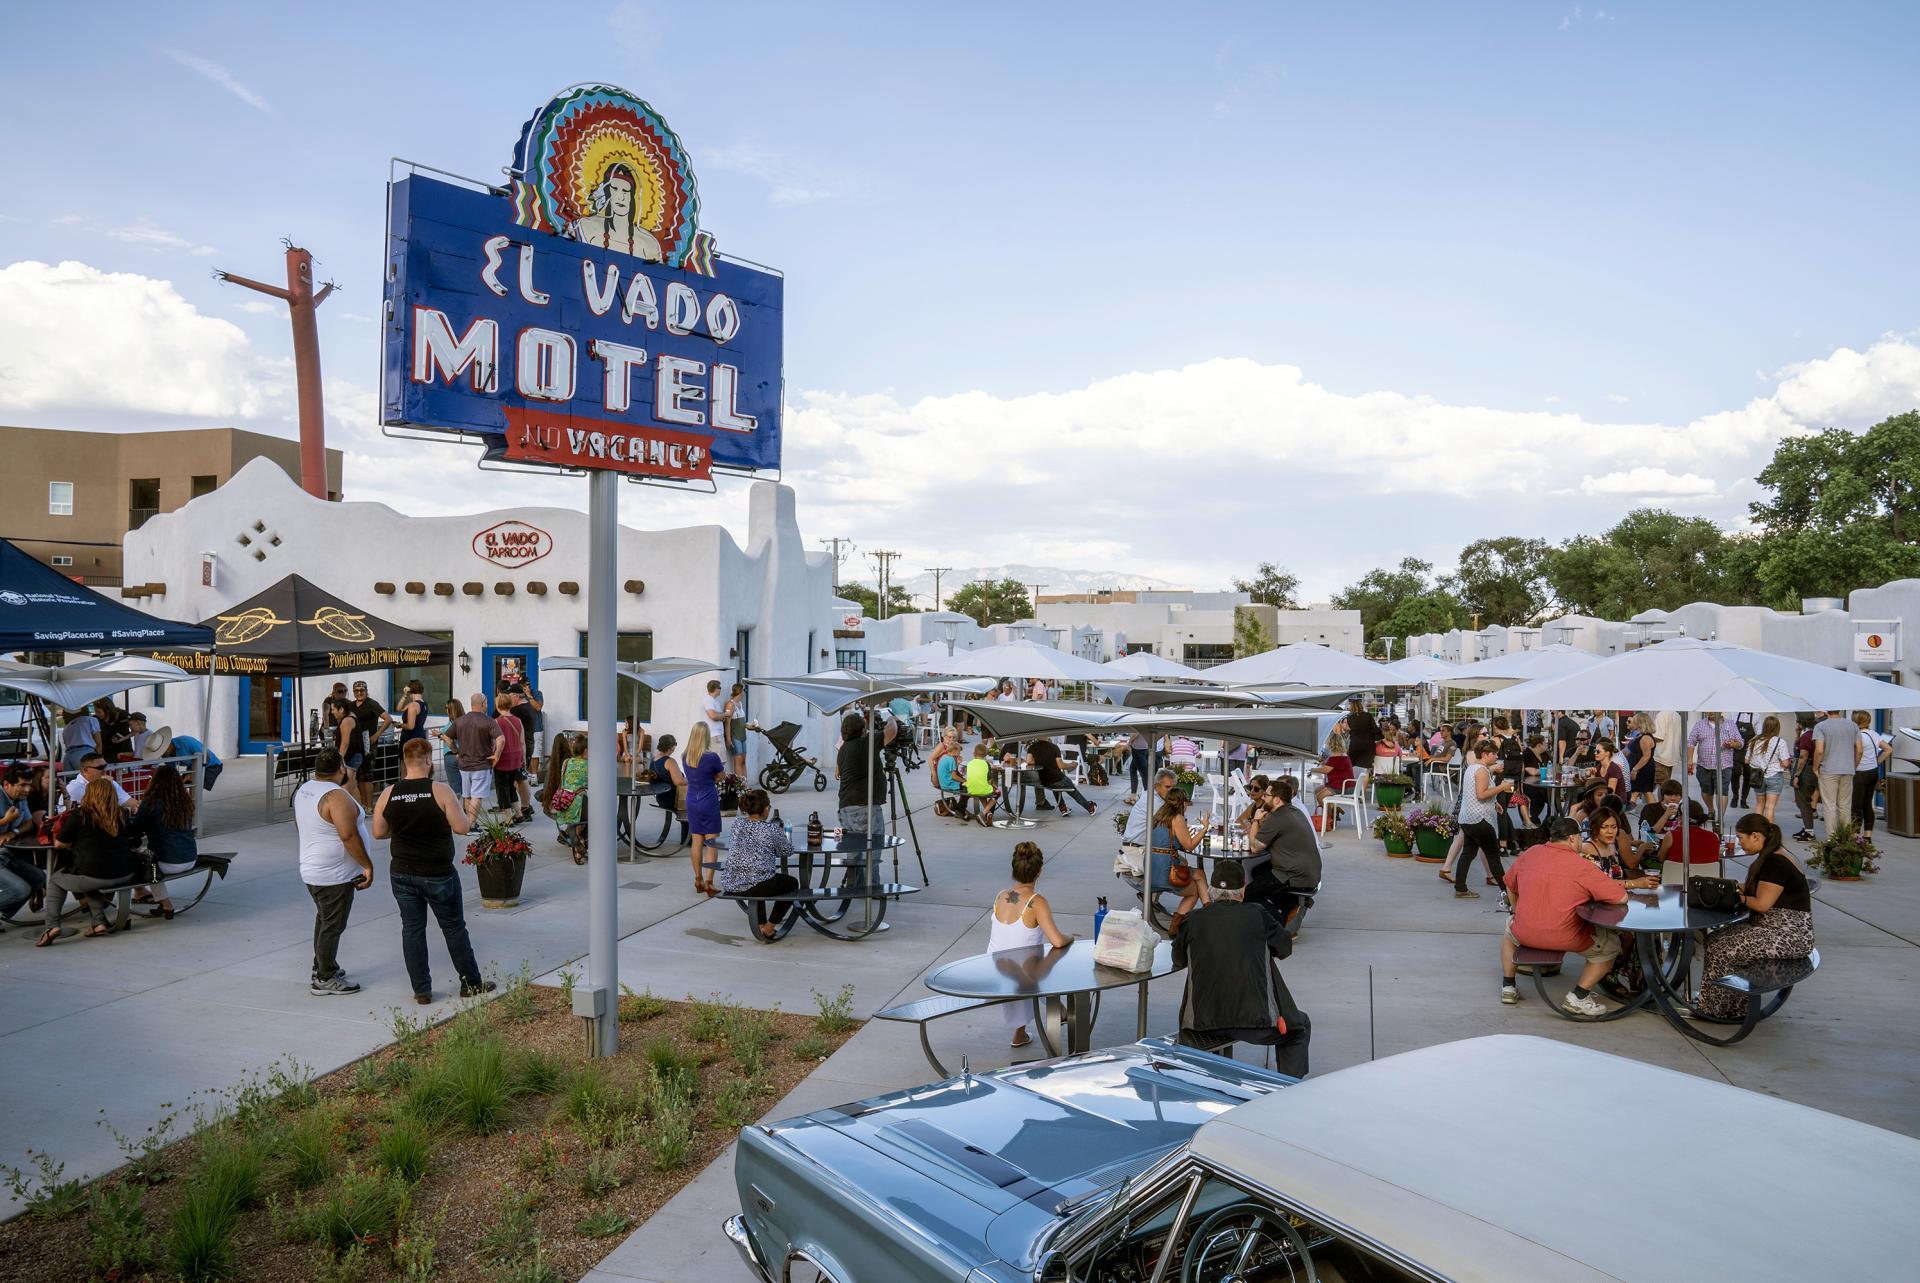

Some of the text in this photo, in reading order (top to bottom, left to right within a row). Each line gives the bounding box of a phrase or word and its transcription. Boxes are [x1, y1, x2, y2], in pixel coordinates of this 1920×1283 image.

[482, 236, 741, 345] EL VADO
[411, 304, 759, 433] MOTEL
[566, 427, 706, 470] VACANCY
[485, 532, 540, 546] EL VADO
[486, 546, 538, 558] TAPROOM
[34, 629, 165, 641] SavingPlaces.org #SavingPlaces
[195, 651, 229, 673] Breing
[229, 654, 269, 674] Company
[328, 647, 431, 668] Ponderosa Brewing Company
